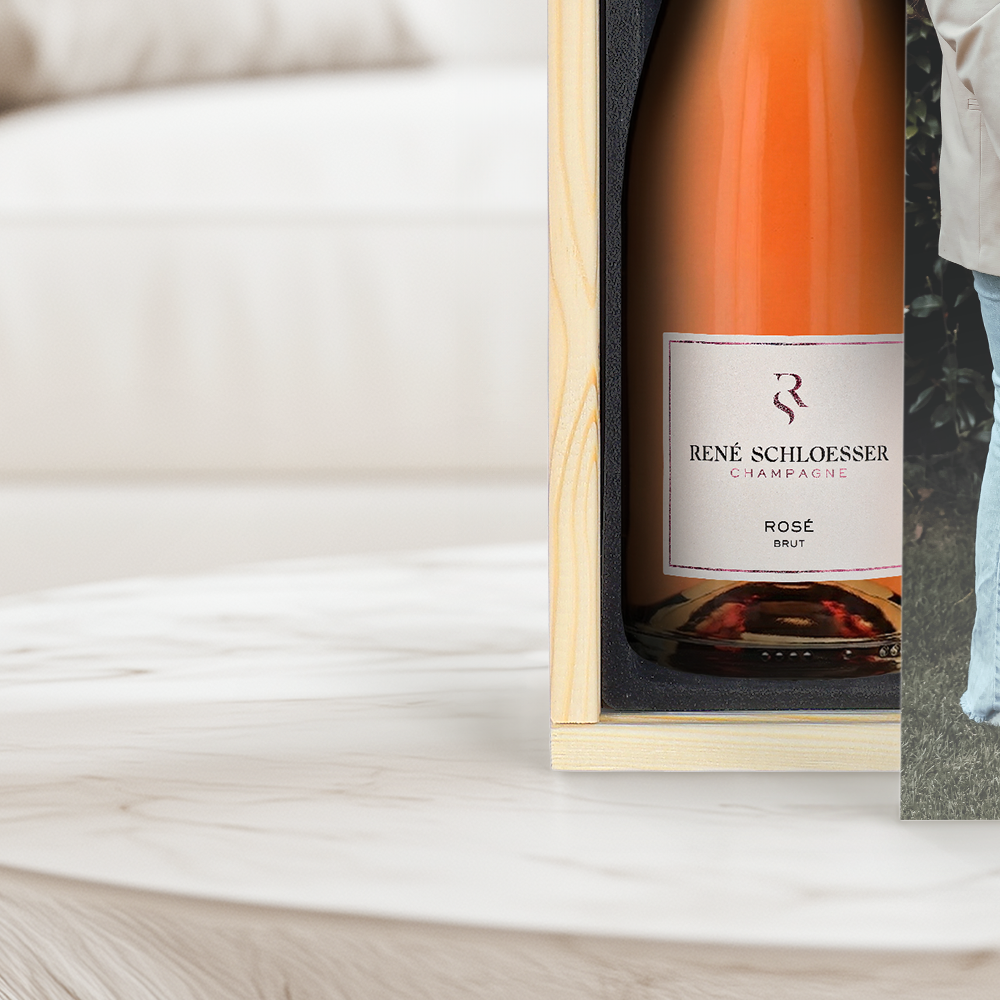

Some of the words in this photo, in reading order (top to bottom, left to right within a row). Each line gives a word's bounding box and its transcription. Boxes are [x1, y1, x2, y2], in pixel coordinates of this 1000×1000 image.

[689, 442, 743, 462] RENÉ
[751, 445, 890, 463] SCHLOESSER
[730, 467, 848, 479] CHAMPAGNE
[764, 518, 815, 533] ROSÉ
[773, 539, 806, 548] BRUT
